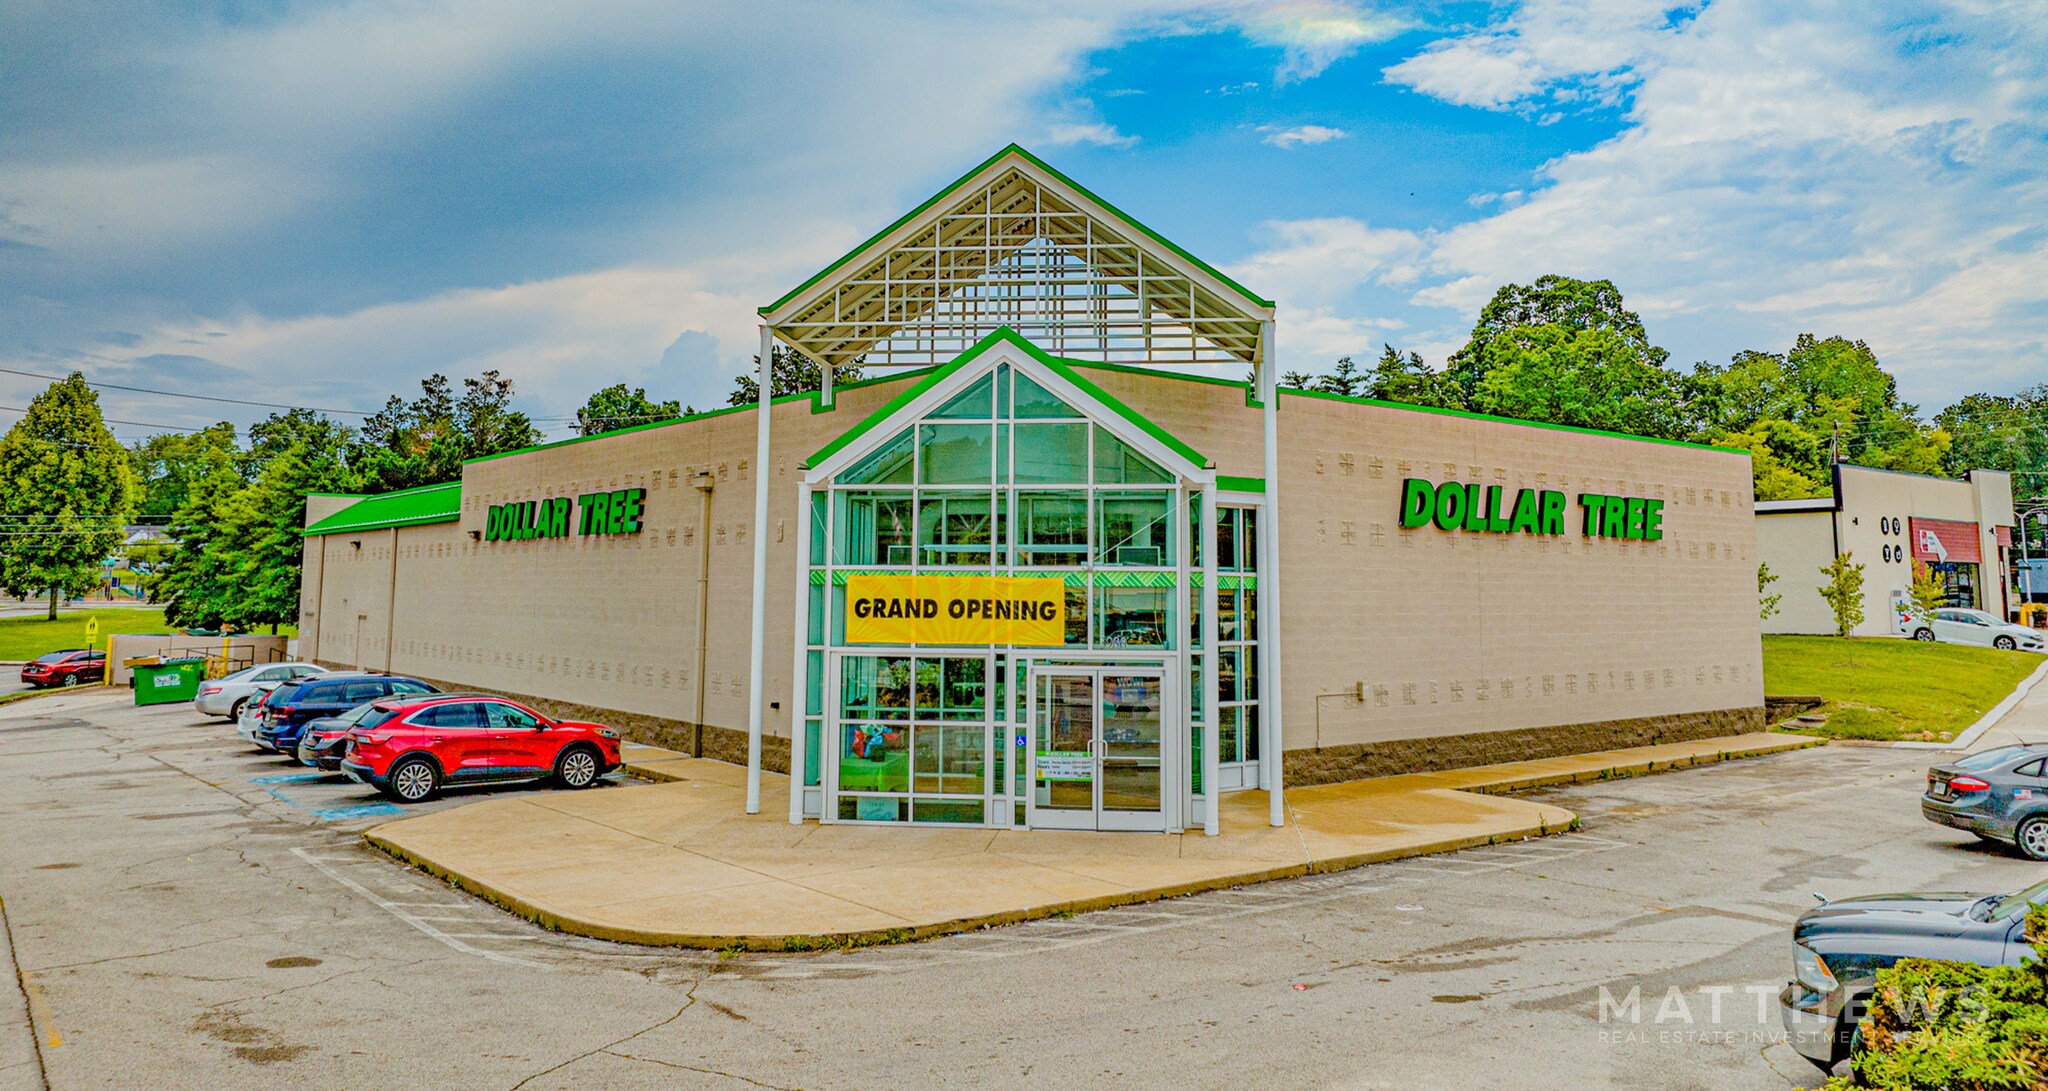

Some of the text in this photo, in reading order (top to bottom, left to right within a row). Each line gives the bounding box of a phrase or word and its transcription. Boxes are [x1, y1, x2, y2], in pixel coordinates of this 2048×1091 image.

[485, 488, 646, 541] DOLLAR TREE
[1399, 478, 1664, 540] DOLLAR TREE
[854, 598, 1057, 621] GRAND OPENING
